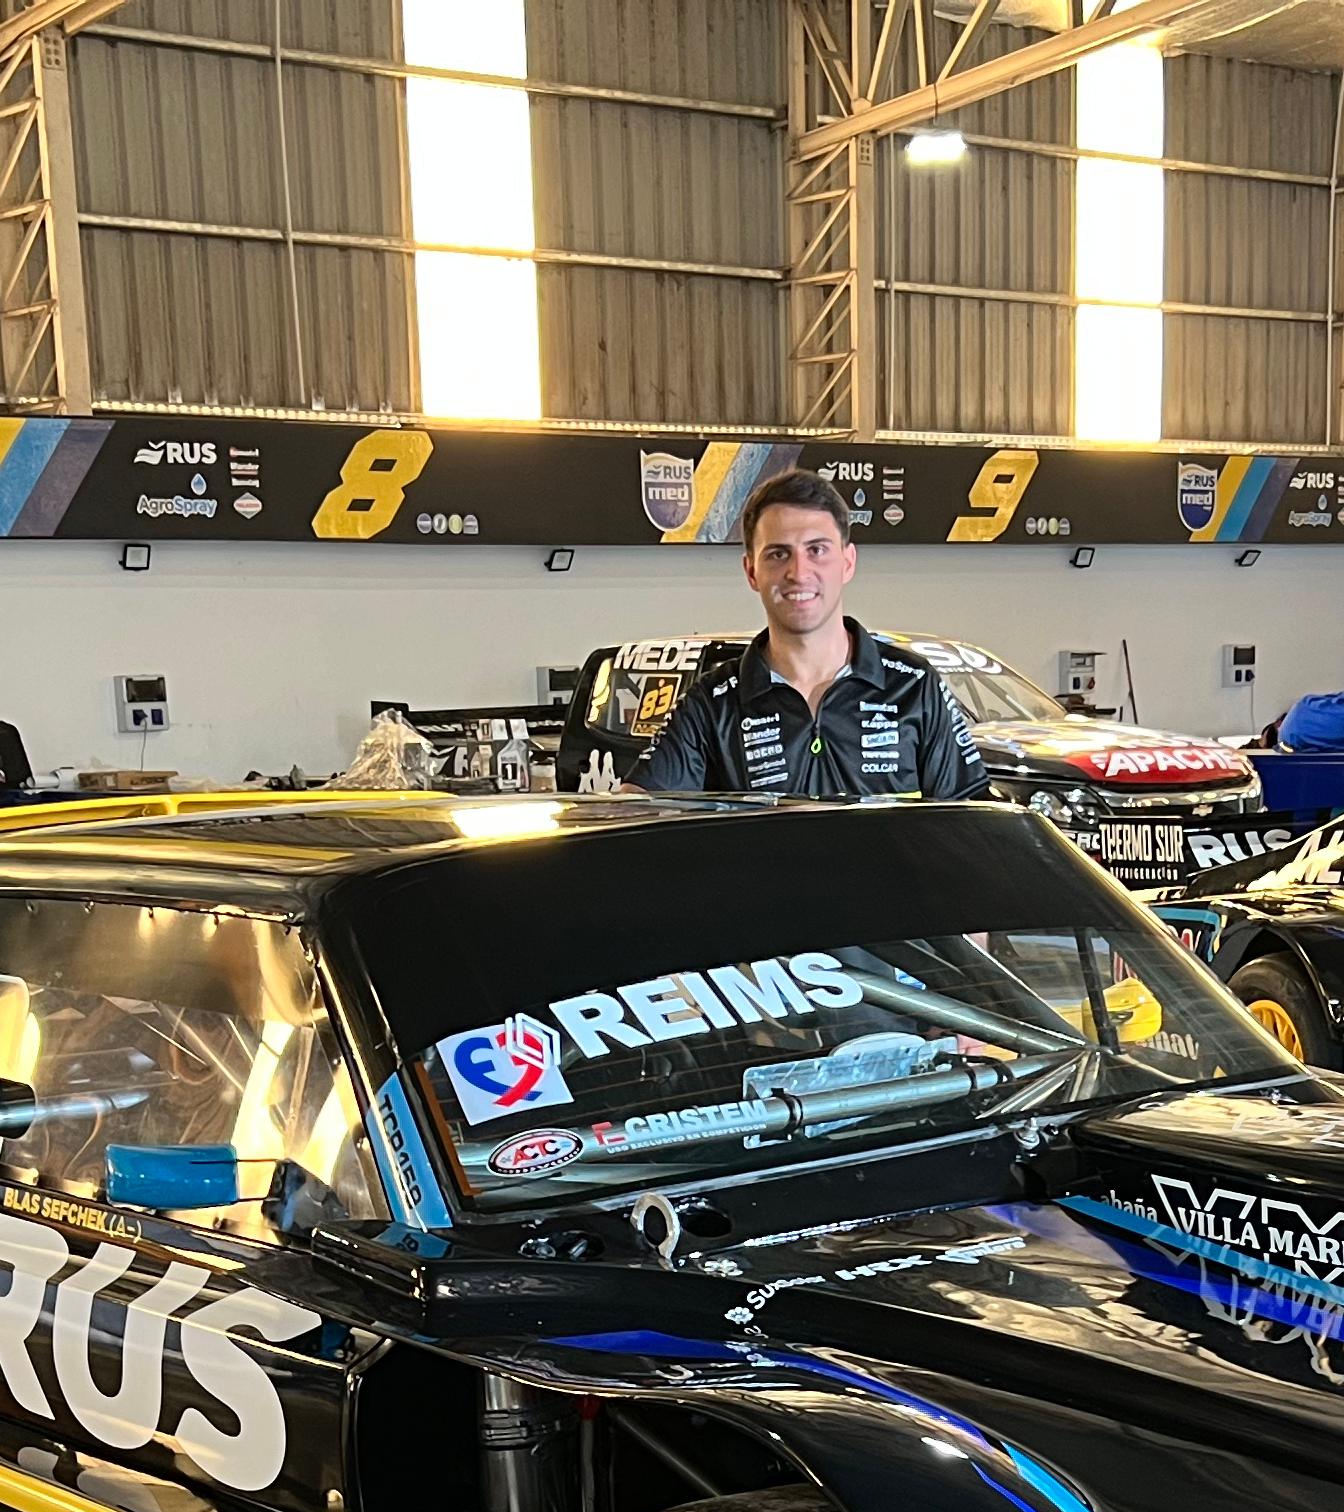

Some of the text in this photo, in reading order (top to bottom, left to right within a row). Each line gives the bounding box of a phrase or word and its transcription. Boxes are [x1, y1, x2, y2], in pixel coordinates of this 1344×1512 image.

[166, 442, 218, 465] RUS
[311, 429, 435, 540] 8
[663, 465, 692, 480] RUS
[838, 462, 874, 482] RUS
[1193, 473, 1216, 488] RUS
[1307, 471, 1335, 489] RUS
[136, 493, 218, 518] AgroSpray
[647, 485, 688, 501] med
[944, 450, 1040, 542] 9
[1181, 491, 1212, 506] med
[847, 509, 874, 527] pray
[1287, 510, 1333, 528] AgroSpray
[881, 658, 926, 680] roSpray
[639, 683, 675, 721] 83
[1105, 748, 1245, 777] APACHE
[1099, 824, 1185, 864] THERMO SUR
[1187, 828, 1293, 868] RUS
[549, 952, 863, 1059] REIMS
[623, 1098, 769, 1138] CRISTEM
[512, 1138, 559, 1167] ACTC
[606, 1145, 630, 1155] USO
[630, 1134, 685, 1151] EXCLUSIVO
[685, 1132, 701, 1141] EN
[3, 1187, 42, 1215] BLAS
[40, 1196, 109, 1232] SEFCHEK
[1100, 1189, 1158, 1231] abaña
[1176, 1205, 1260, 1250] VILLA
